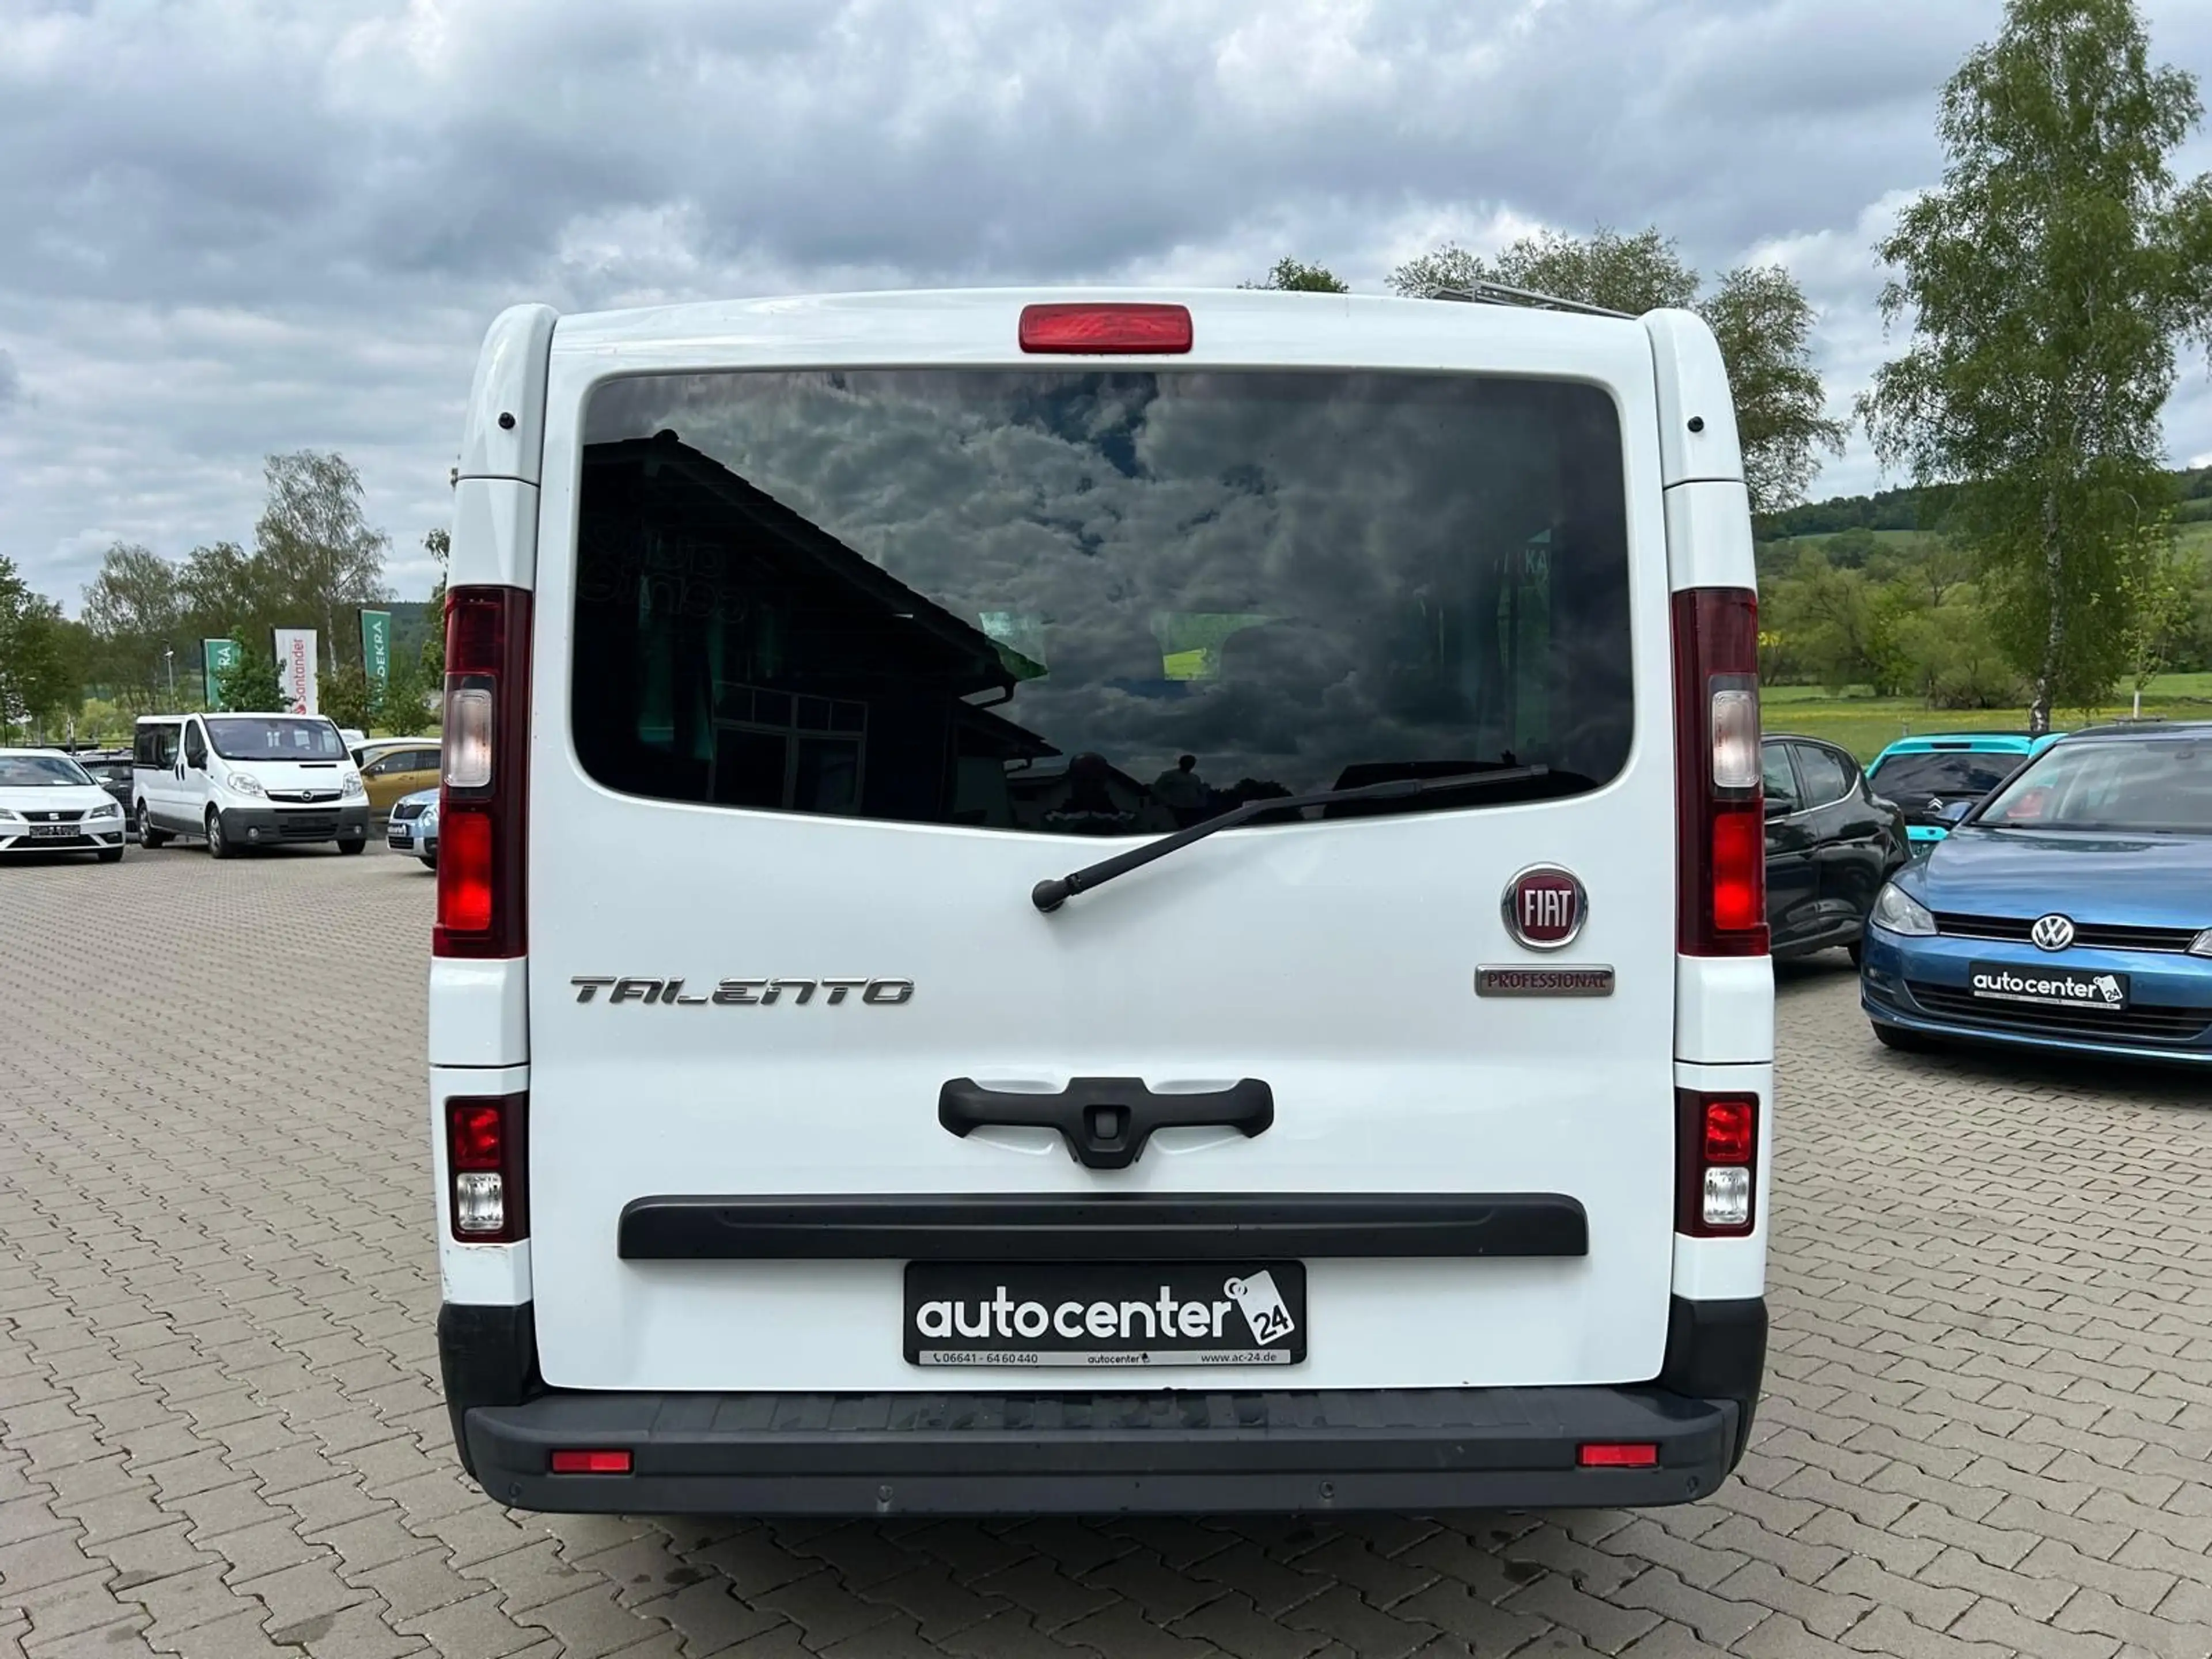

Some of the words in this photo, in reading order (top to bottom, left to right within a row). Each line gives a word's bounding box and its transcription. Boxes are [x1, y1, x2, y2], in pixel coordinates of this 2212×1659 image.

[372, 620, 386, 677] DEKRA
[292, 638, 306, 702] Santander
[1524, 889, 1571, 927] FIAT
[570, 976, 916, 1005] TALENTO
[1487, 972, 1607, 989] PROFESSIONAL
[2105, 988, 2120, 1001] 24
[1253, 1305, 1289, 1340] 24
[942, 1353, 976, 1363] 06641
[1088, 1355, 1140, 1364] autocenter
[1201, 1353, 1278, 1362] www.ac-24.de
